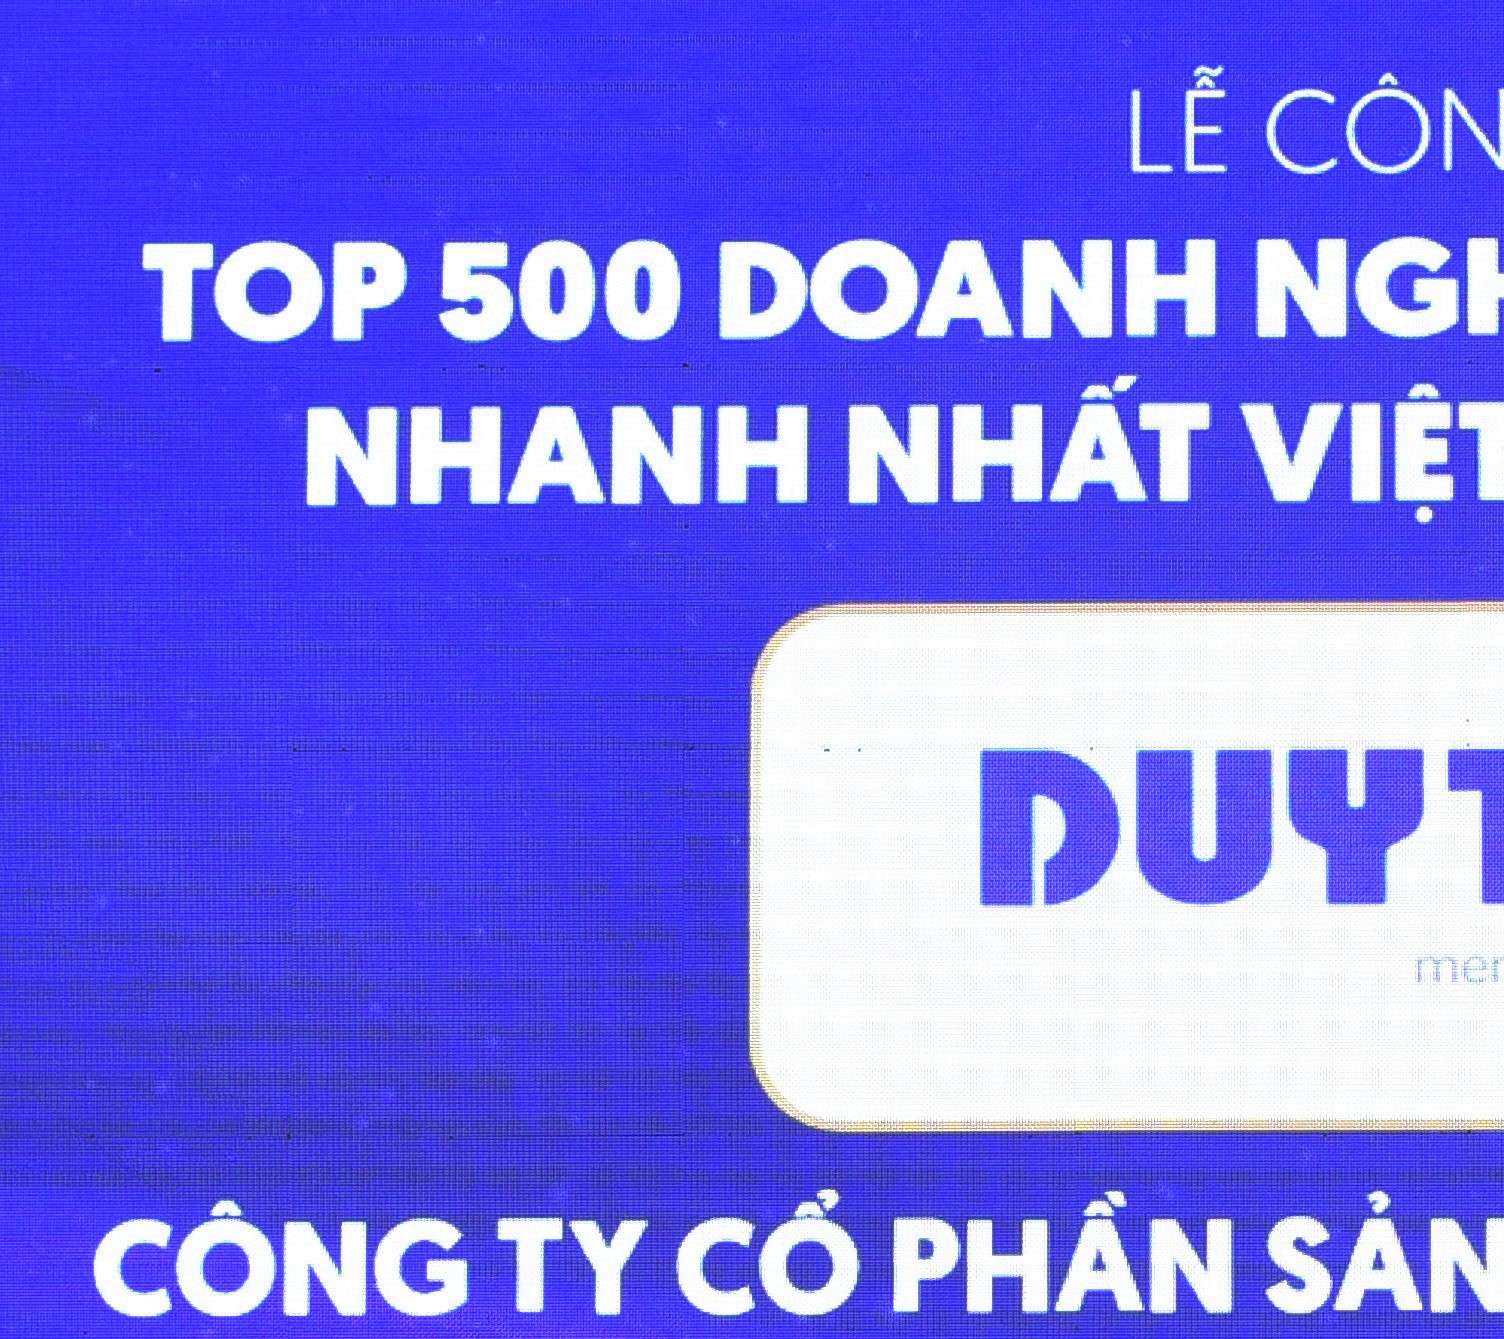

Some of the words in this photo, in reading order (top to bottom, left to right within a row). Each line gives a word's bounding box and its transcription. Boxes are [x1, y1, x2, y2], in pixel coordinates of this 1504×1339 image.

[1130, 64, 1226, 173] LỄ
[142, 241, 406, 342] TOP
[439, 240, 681, 341] 500
[720, 239, 1216, 340] DOANH
[306, 406, 808, 506] NHANH
[848, 375, 1210, 504] NHẤT
[93, 1200, 467, 1317] CÔNG
[497, 1218, 647, 1315] TY
[676, 1189, 859, 1316] CỔ
[893, 1191, 1232, 1313] PHẦN
